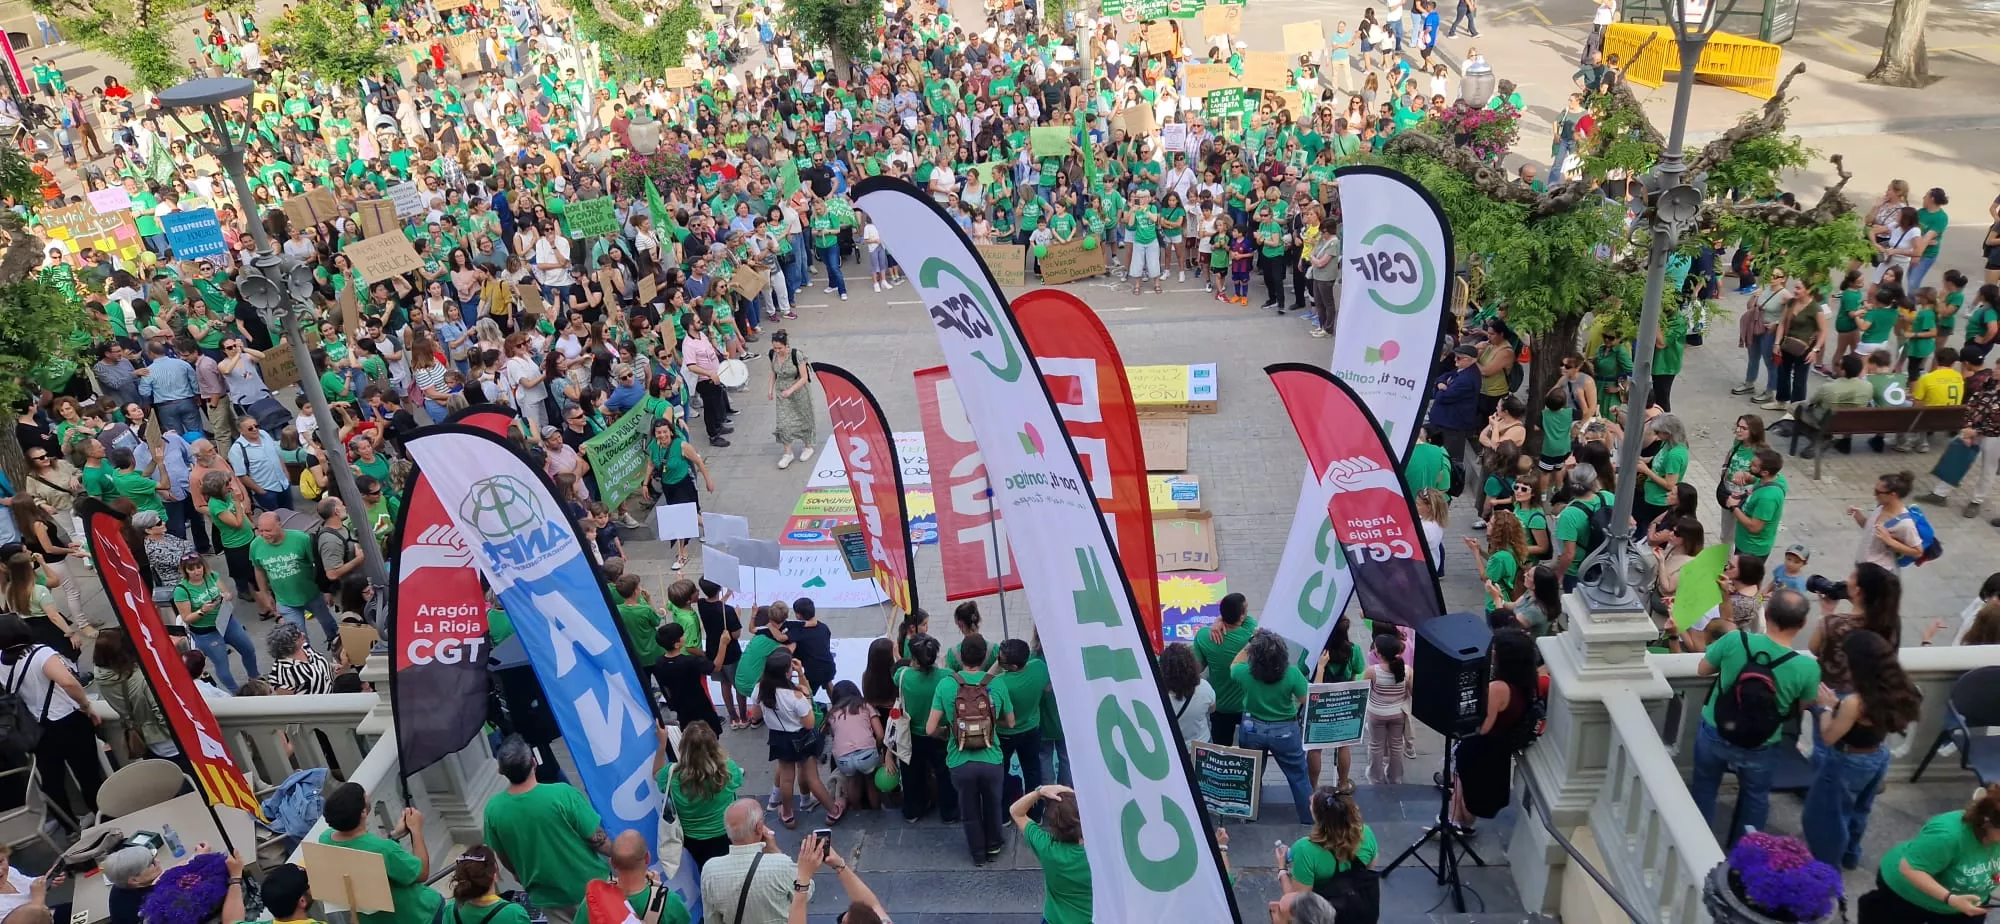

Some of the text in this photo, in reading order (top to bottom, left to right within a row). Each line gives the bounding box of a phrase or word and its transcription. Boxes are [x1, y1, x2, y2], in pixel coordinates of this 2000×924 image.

[1884, 382, 1906, 405] 6
[1948, 385, 1959, 405] 9
[417, 603, 479, 622] Aragón
[414, 619, 481, 636] La Rioja
[407, 638, 485, 666] CGT
[1201, 762, 1248, 776] EDUCATIVA
[1209, 756, 1241, 767] HUELGA
